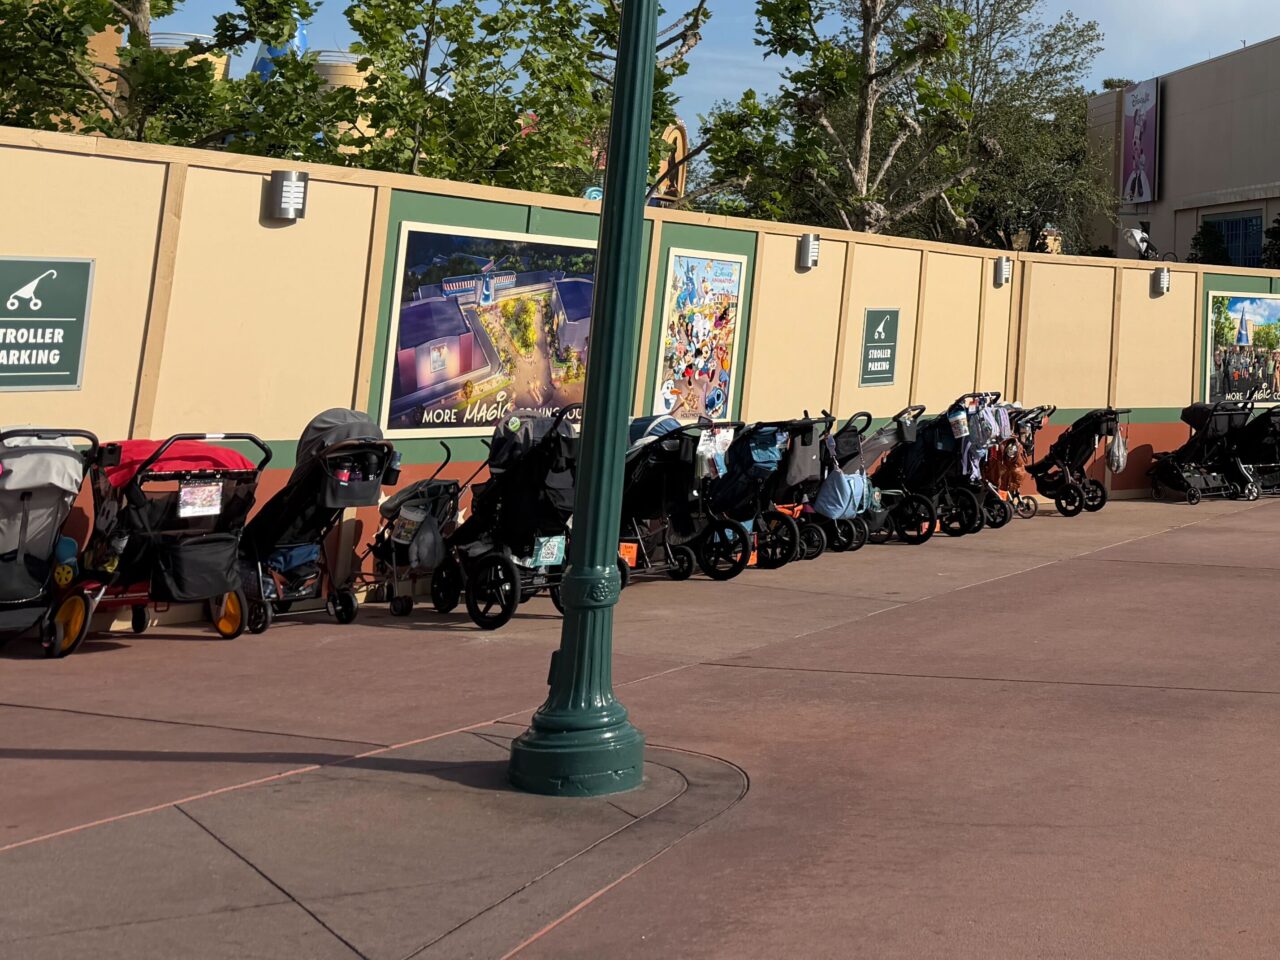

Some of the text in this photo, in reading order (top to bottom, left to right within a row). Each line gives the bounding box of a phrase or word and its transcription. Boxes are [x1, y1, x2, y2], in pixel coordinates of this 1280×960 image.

[868, 349, 891, 359] STROLLER
[868, 361, 890, 371] PARKING
[1225, 392, 1244, 401] MORE
[422, 409, 457, 423] MORE
